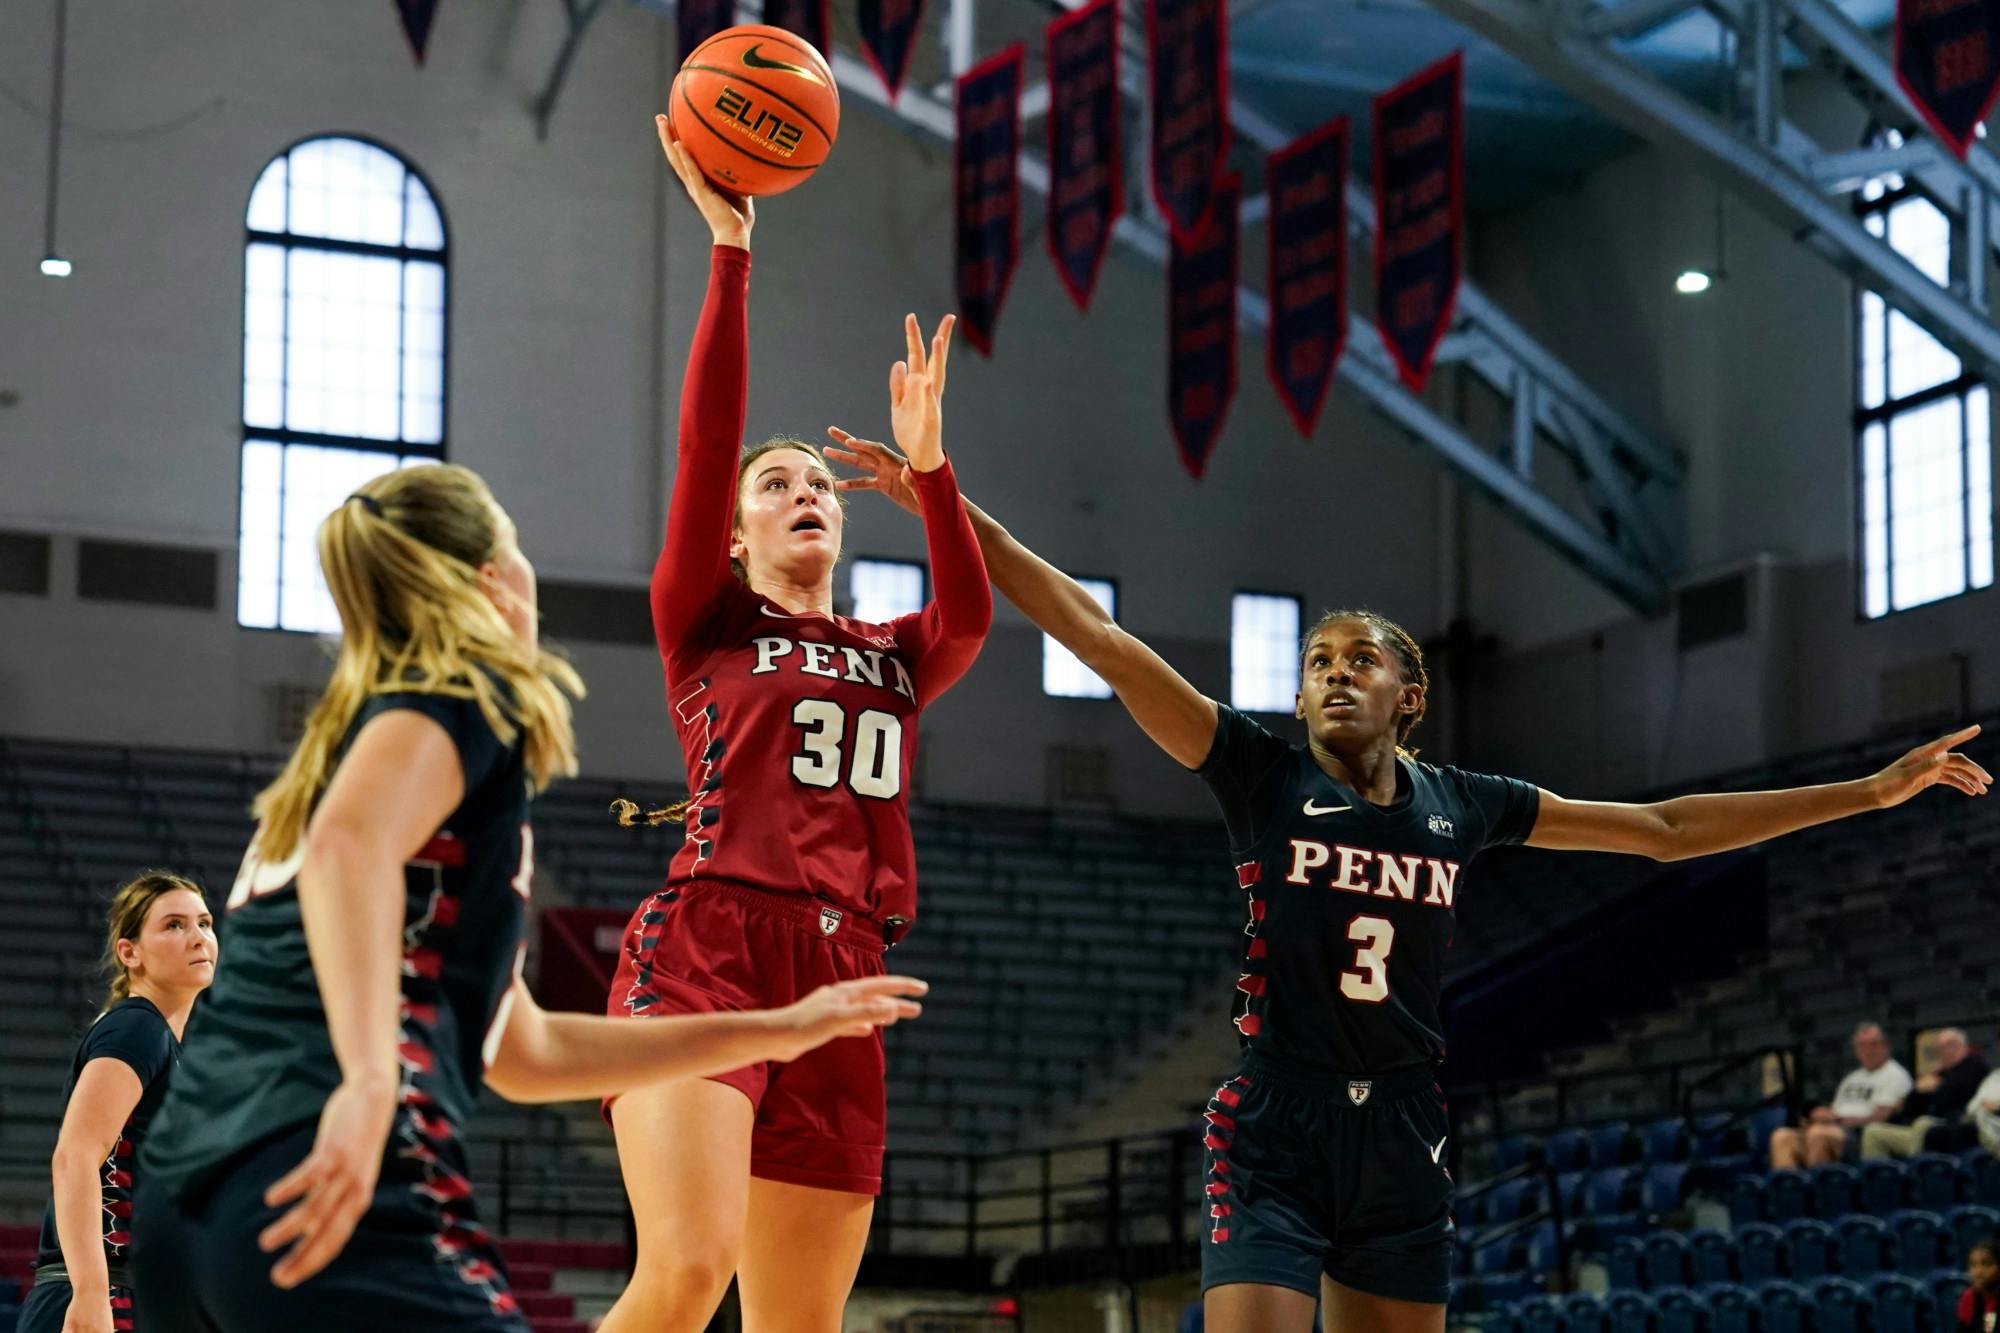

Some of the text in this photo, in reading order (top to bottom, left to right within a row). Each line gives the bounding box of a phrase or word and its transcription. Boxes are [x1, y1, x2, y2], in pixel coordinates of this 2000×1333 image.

[710, 110, 792, 158] AMPIONSHIP
[714, 86, 805, 152] ELITE
[791, 698, 903, 800] 30
[1435, 819, 1454, 832] IVY
[1285, 838, 1460, 908] PENN
[825, 919, 834, 930] P
[1338, 914, 1396, 1004] 3
[1355, 1089, 1365, 1099] P
